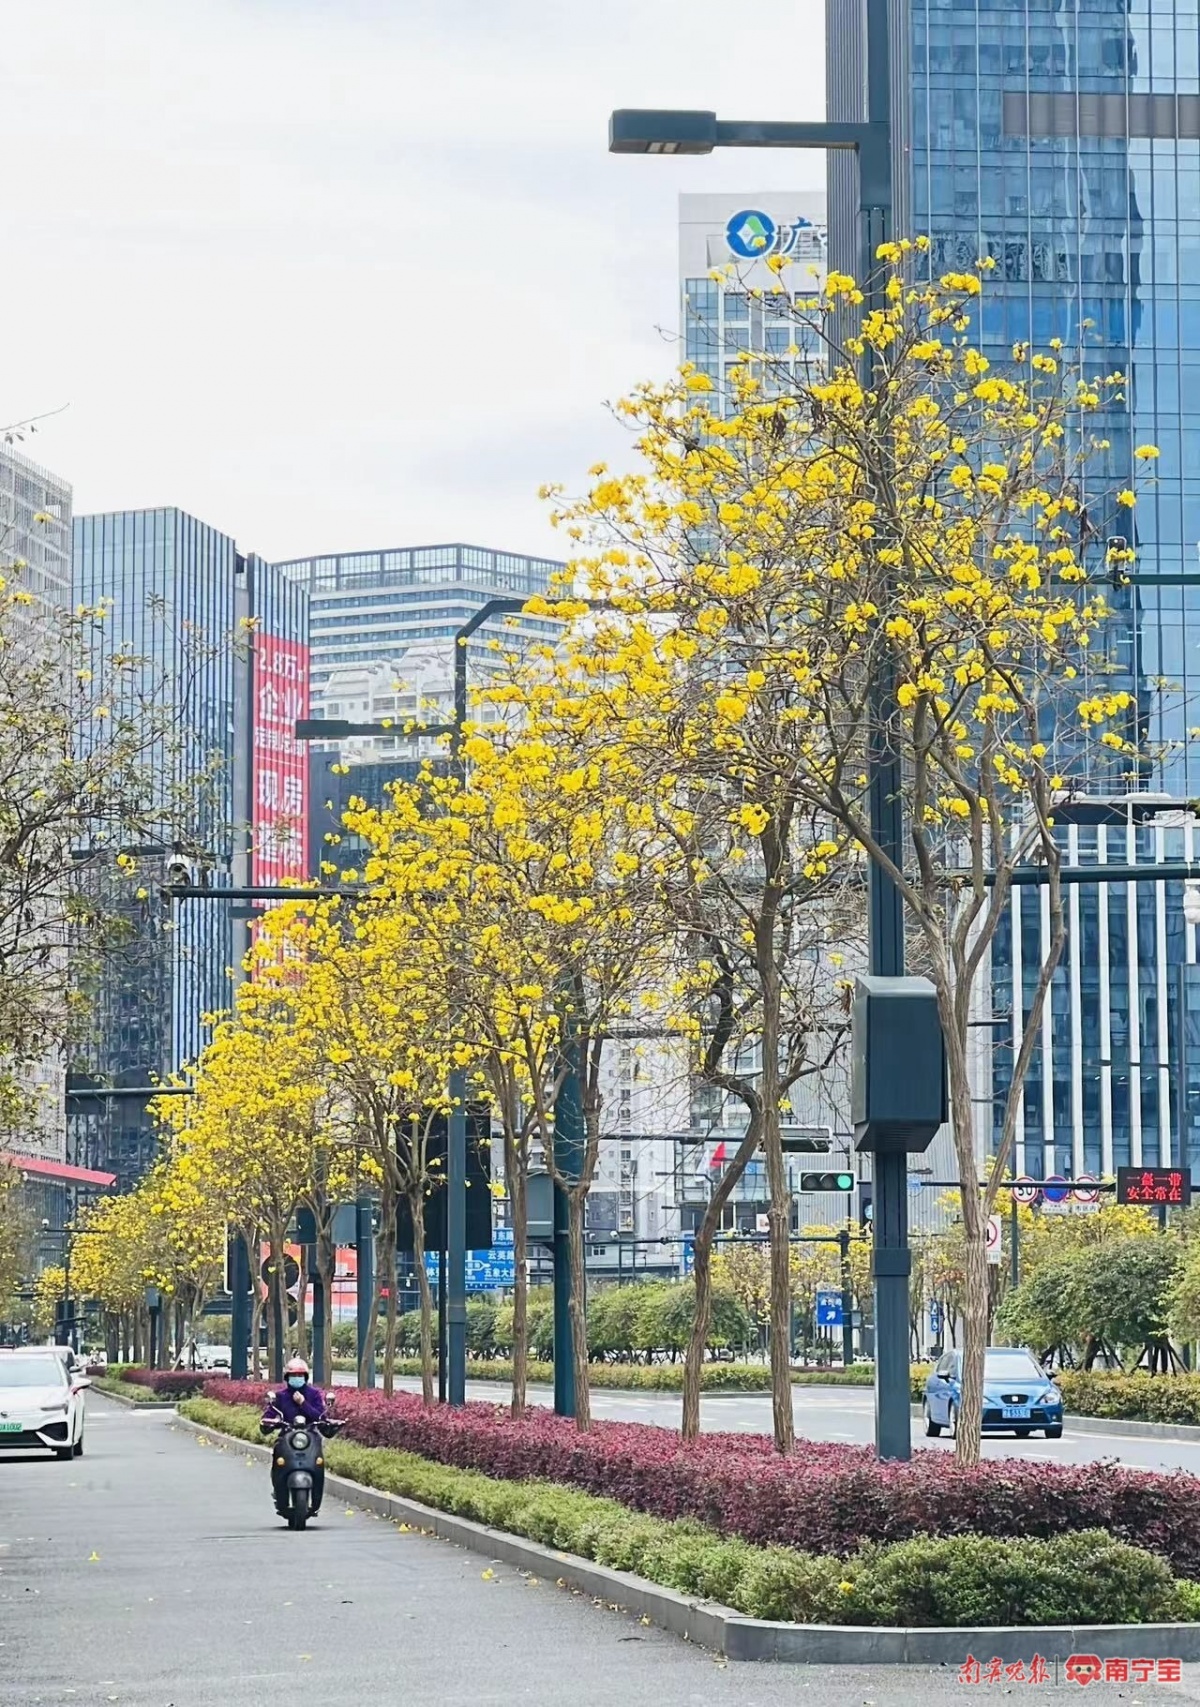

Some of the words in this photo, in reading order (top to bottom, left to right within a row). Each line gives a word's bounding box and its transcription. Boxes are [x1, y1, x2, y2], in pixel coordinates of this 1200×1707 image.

[259, 680, 303, 727] 企业
[258, 769, 302, 817] 现房
[1126, 1172, 1182, 1187] 一盔一带
[1127, 1186, 1182, 1201] 安全常在
